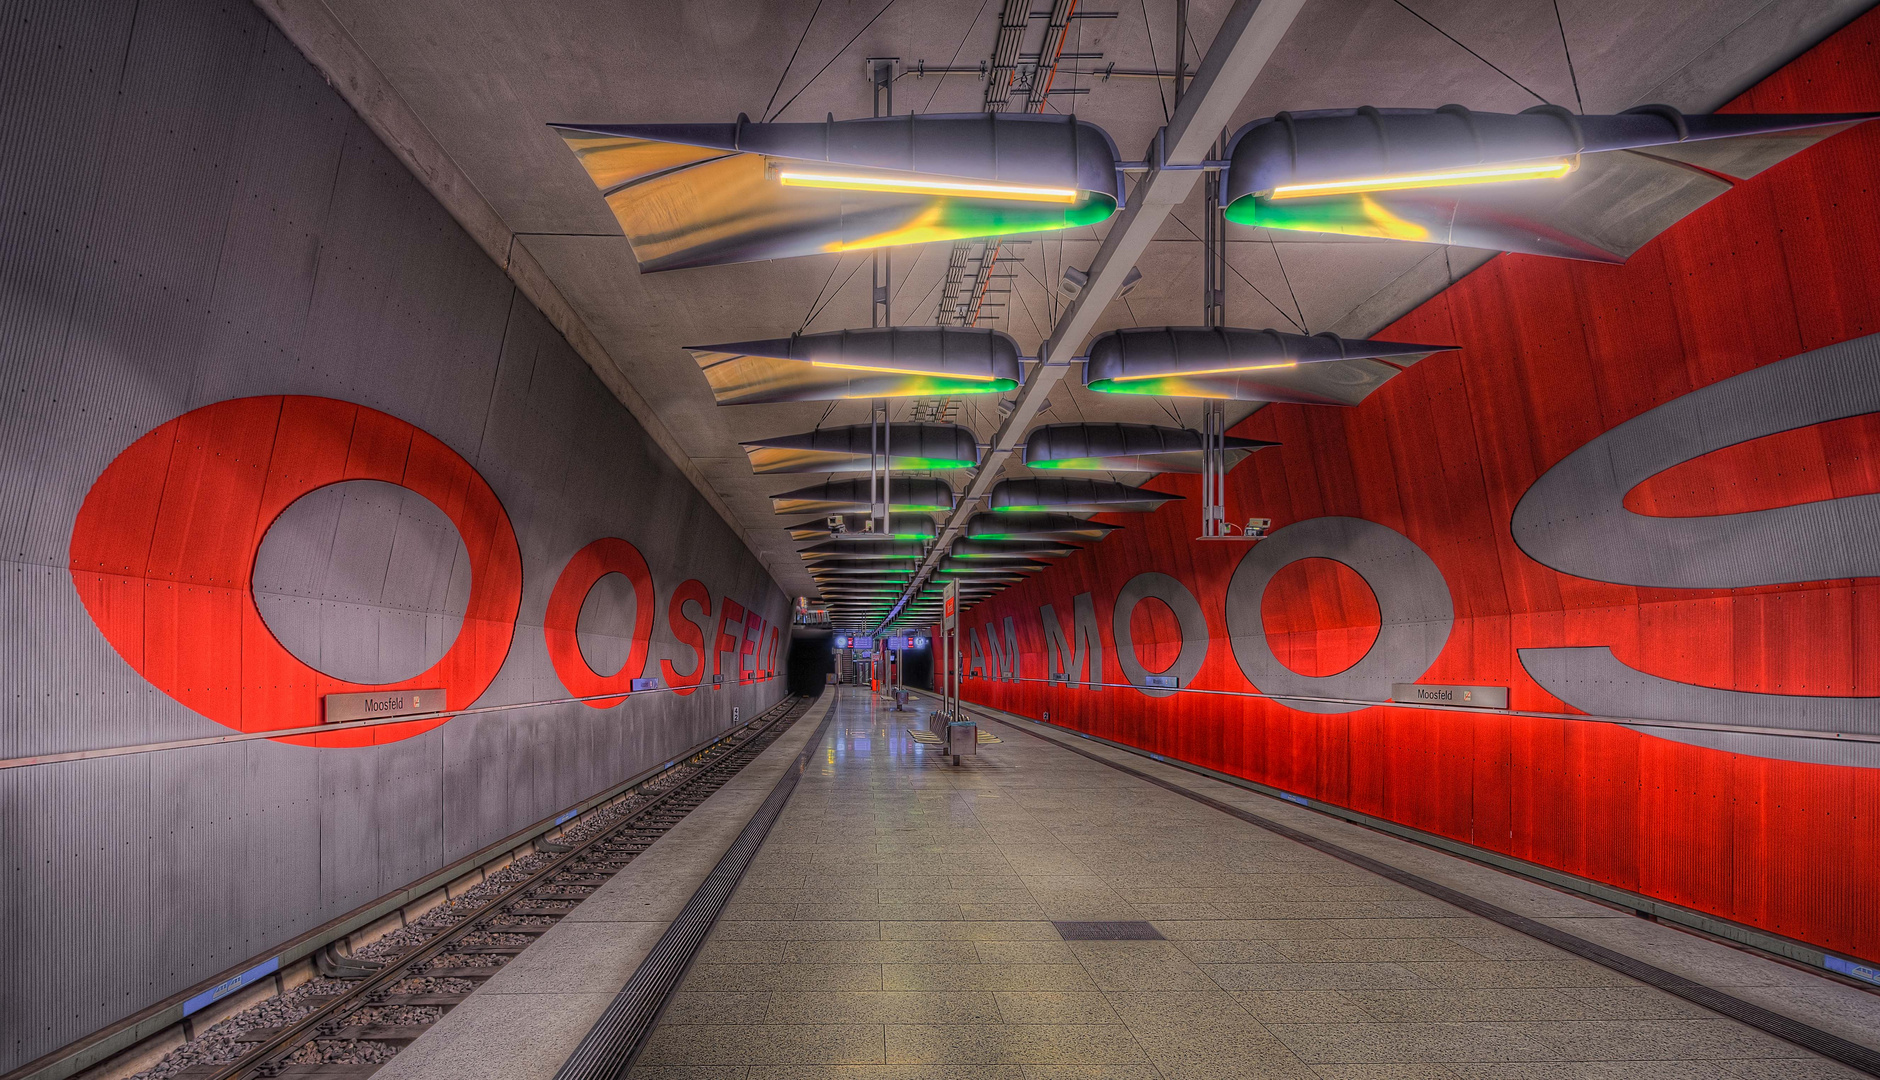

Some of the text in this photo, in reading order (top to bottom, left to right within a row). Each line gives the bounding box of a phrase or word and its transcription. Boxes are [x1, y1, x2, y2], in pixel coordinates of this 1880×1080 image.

[968, 616, 1020, 683] AM
[1417, 688, 1453, 701] Moosfeld
[364, 697, 404, 712] Moosfeld
